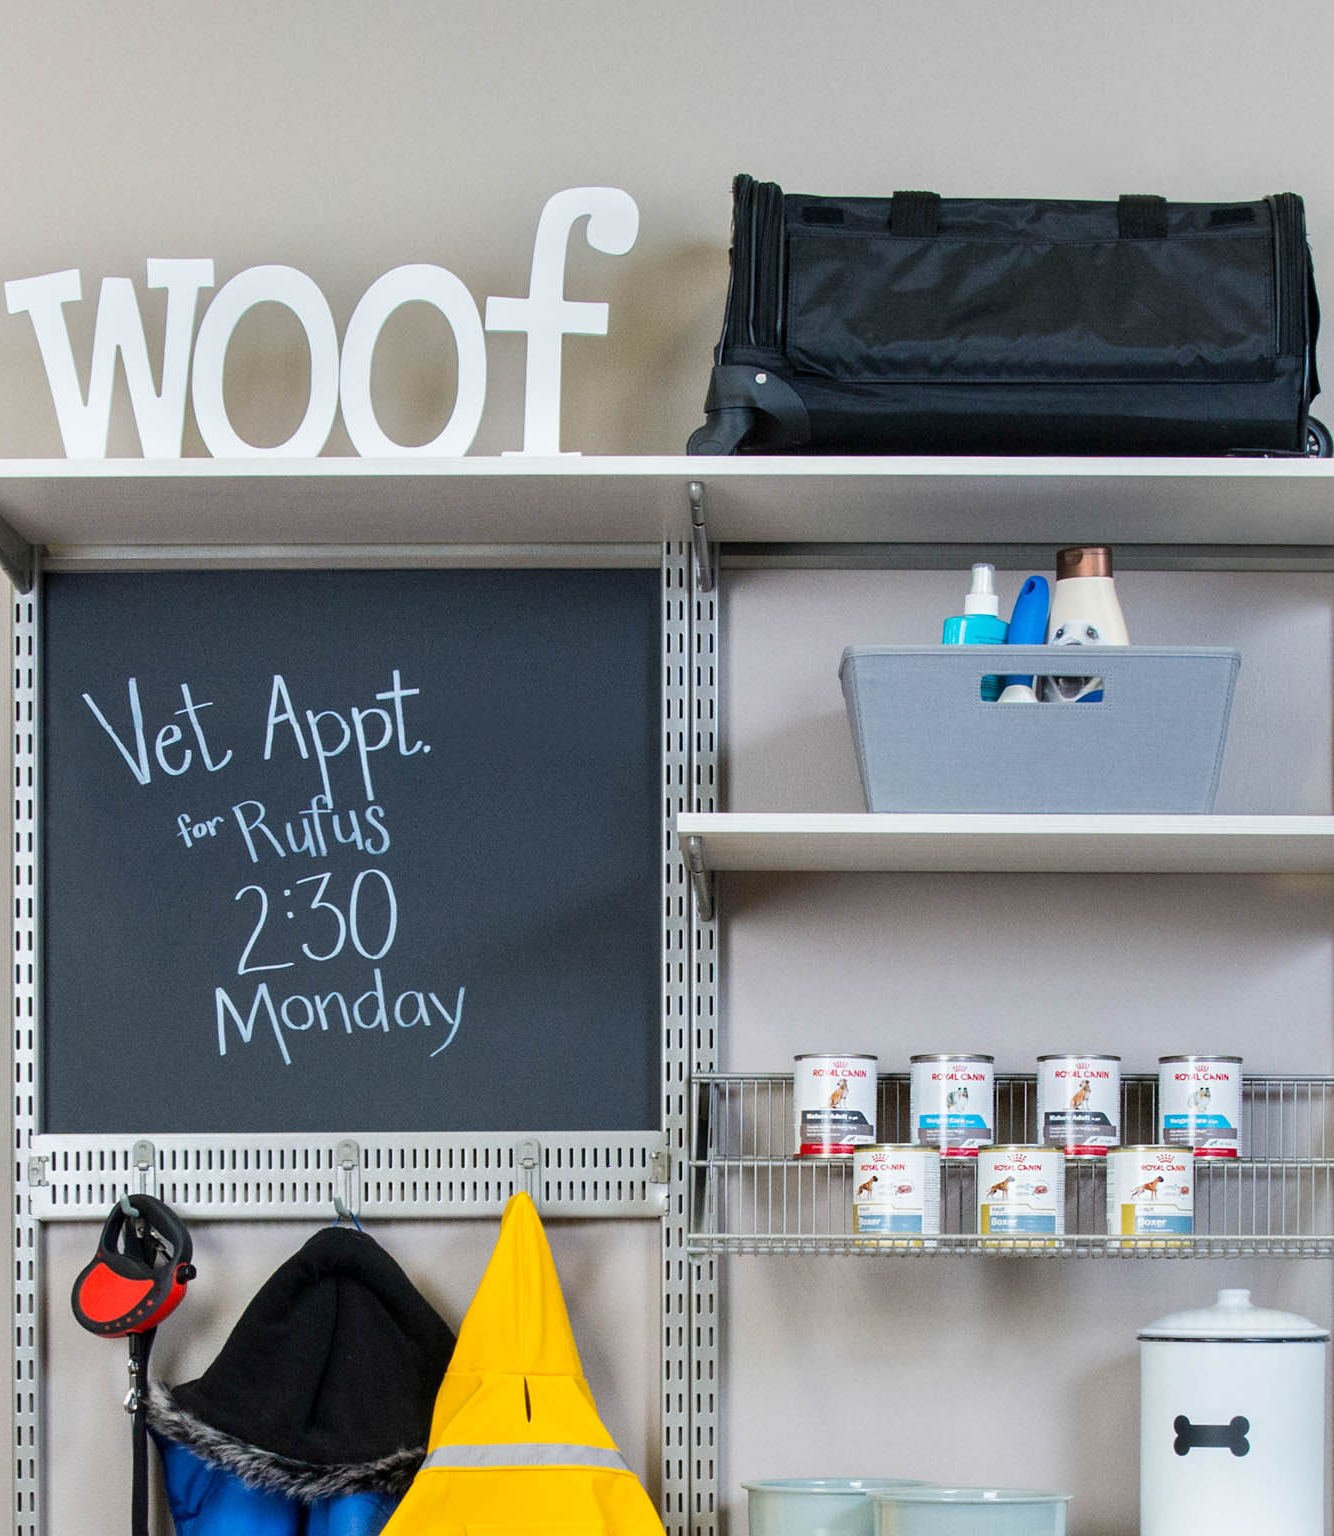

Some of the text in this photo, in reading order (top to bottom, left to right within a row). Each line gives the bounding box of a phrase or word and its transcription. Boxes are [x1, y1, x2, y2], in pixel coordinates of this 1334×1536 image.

[82, 669, 432, 809] Vet Appt.
[176, 795, 391, 864] for Rufus
[234, 868, 399, 976] 2:30
[215, 968, 467, 1066] Monday
[812, 1069, 867, 1078] ROYAL CANIN
[931, 1073, 985, 1081] ROYAL CANIN
[1054, 1070, 1109, 1079] ROYAL CANIN
[1174, 1073, 1229, 1081] ROYAL CANIN
[991, 1217, 1017, 1226] Boxer
